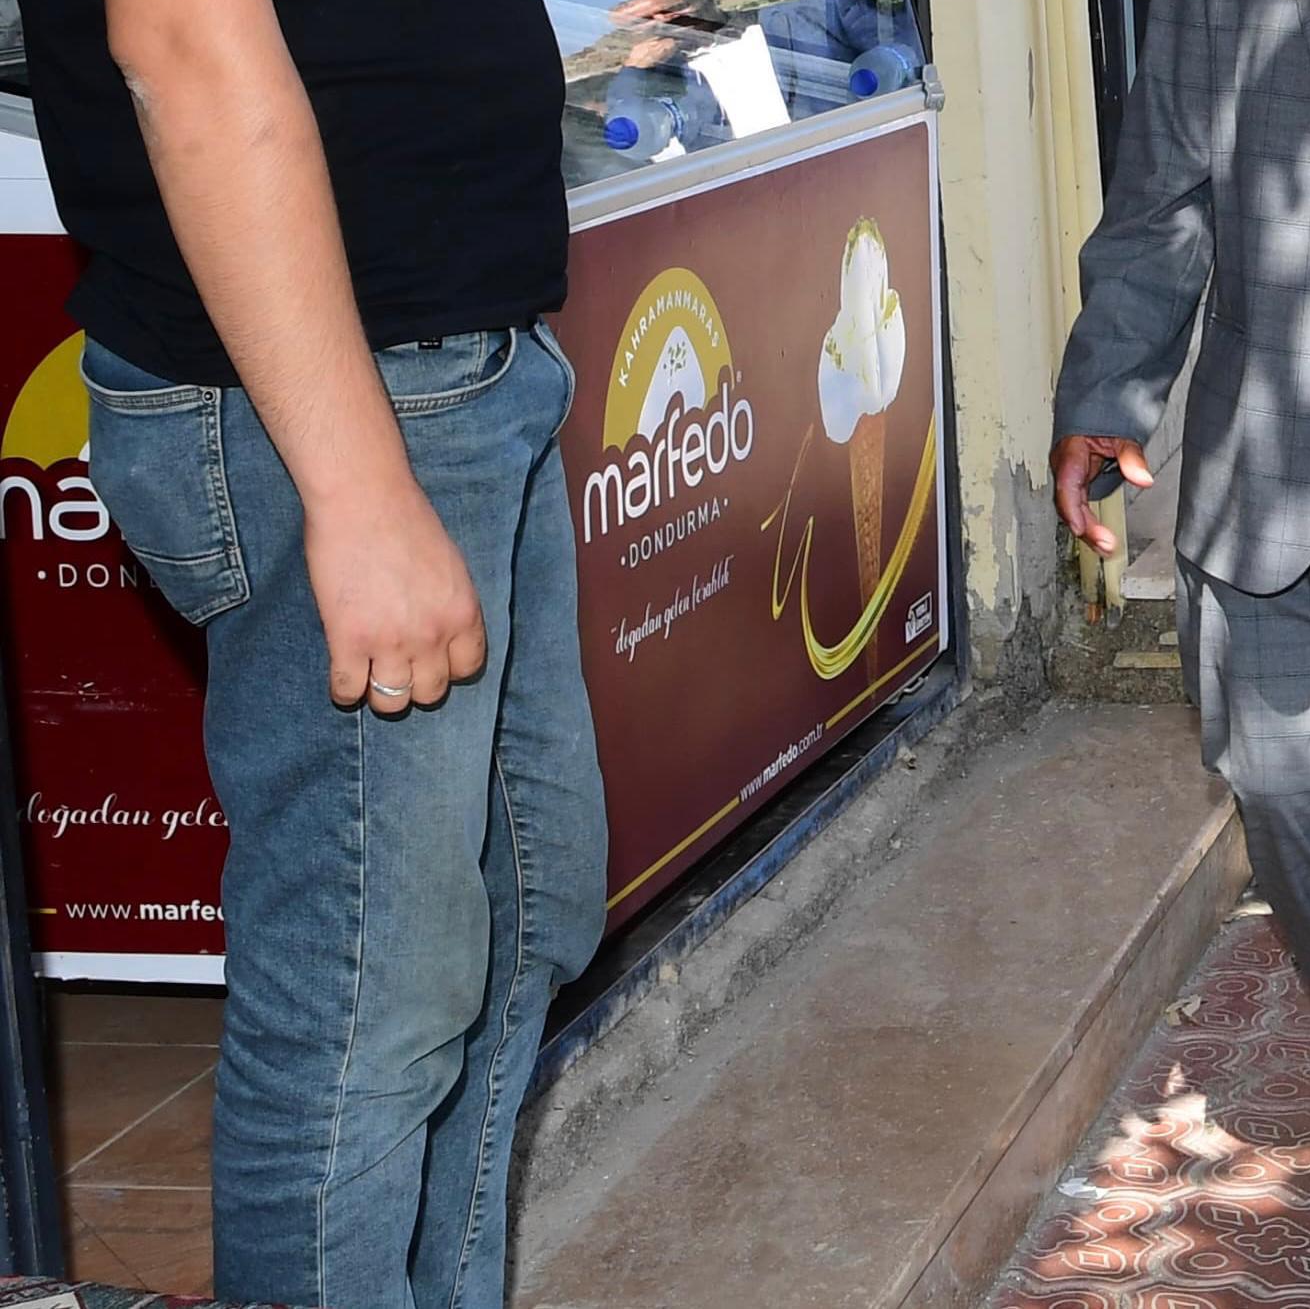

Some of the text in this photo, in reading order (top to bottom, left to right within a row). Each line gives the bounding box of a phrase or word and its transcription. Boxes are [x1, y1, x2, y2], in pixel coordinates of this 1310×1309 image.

[583, 381, 753, 544] marfedo
[629, 497, 721, 568] DONDURMA
[740, 722, 823, 802] www.marfedo.com.tr
